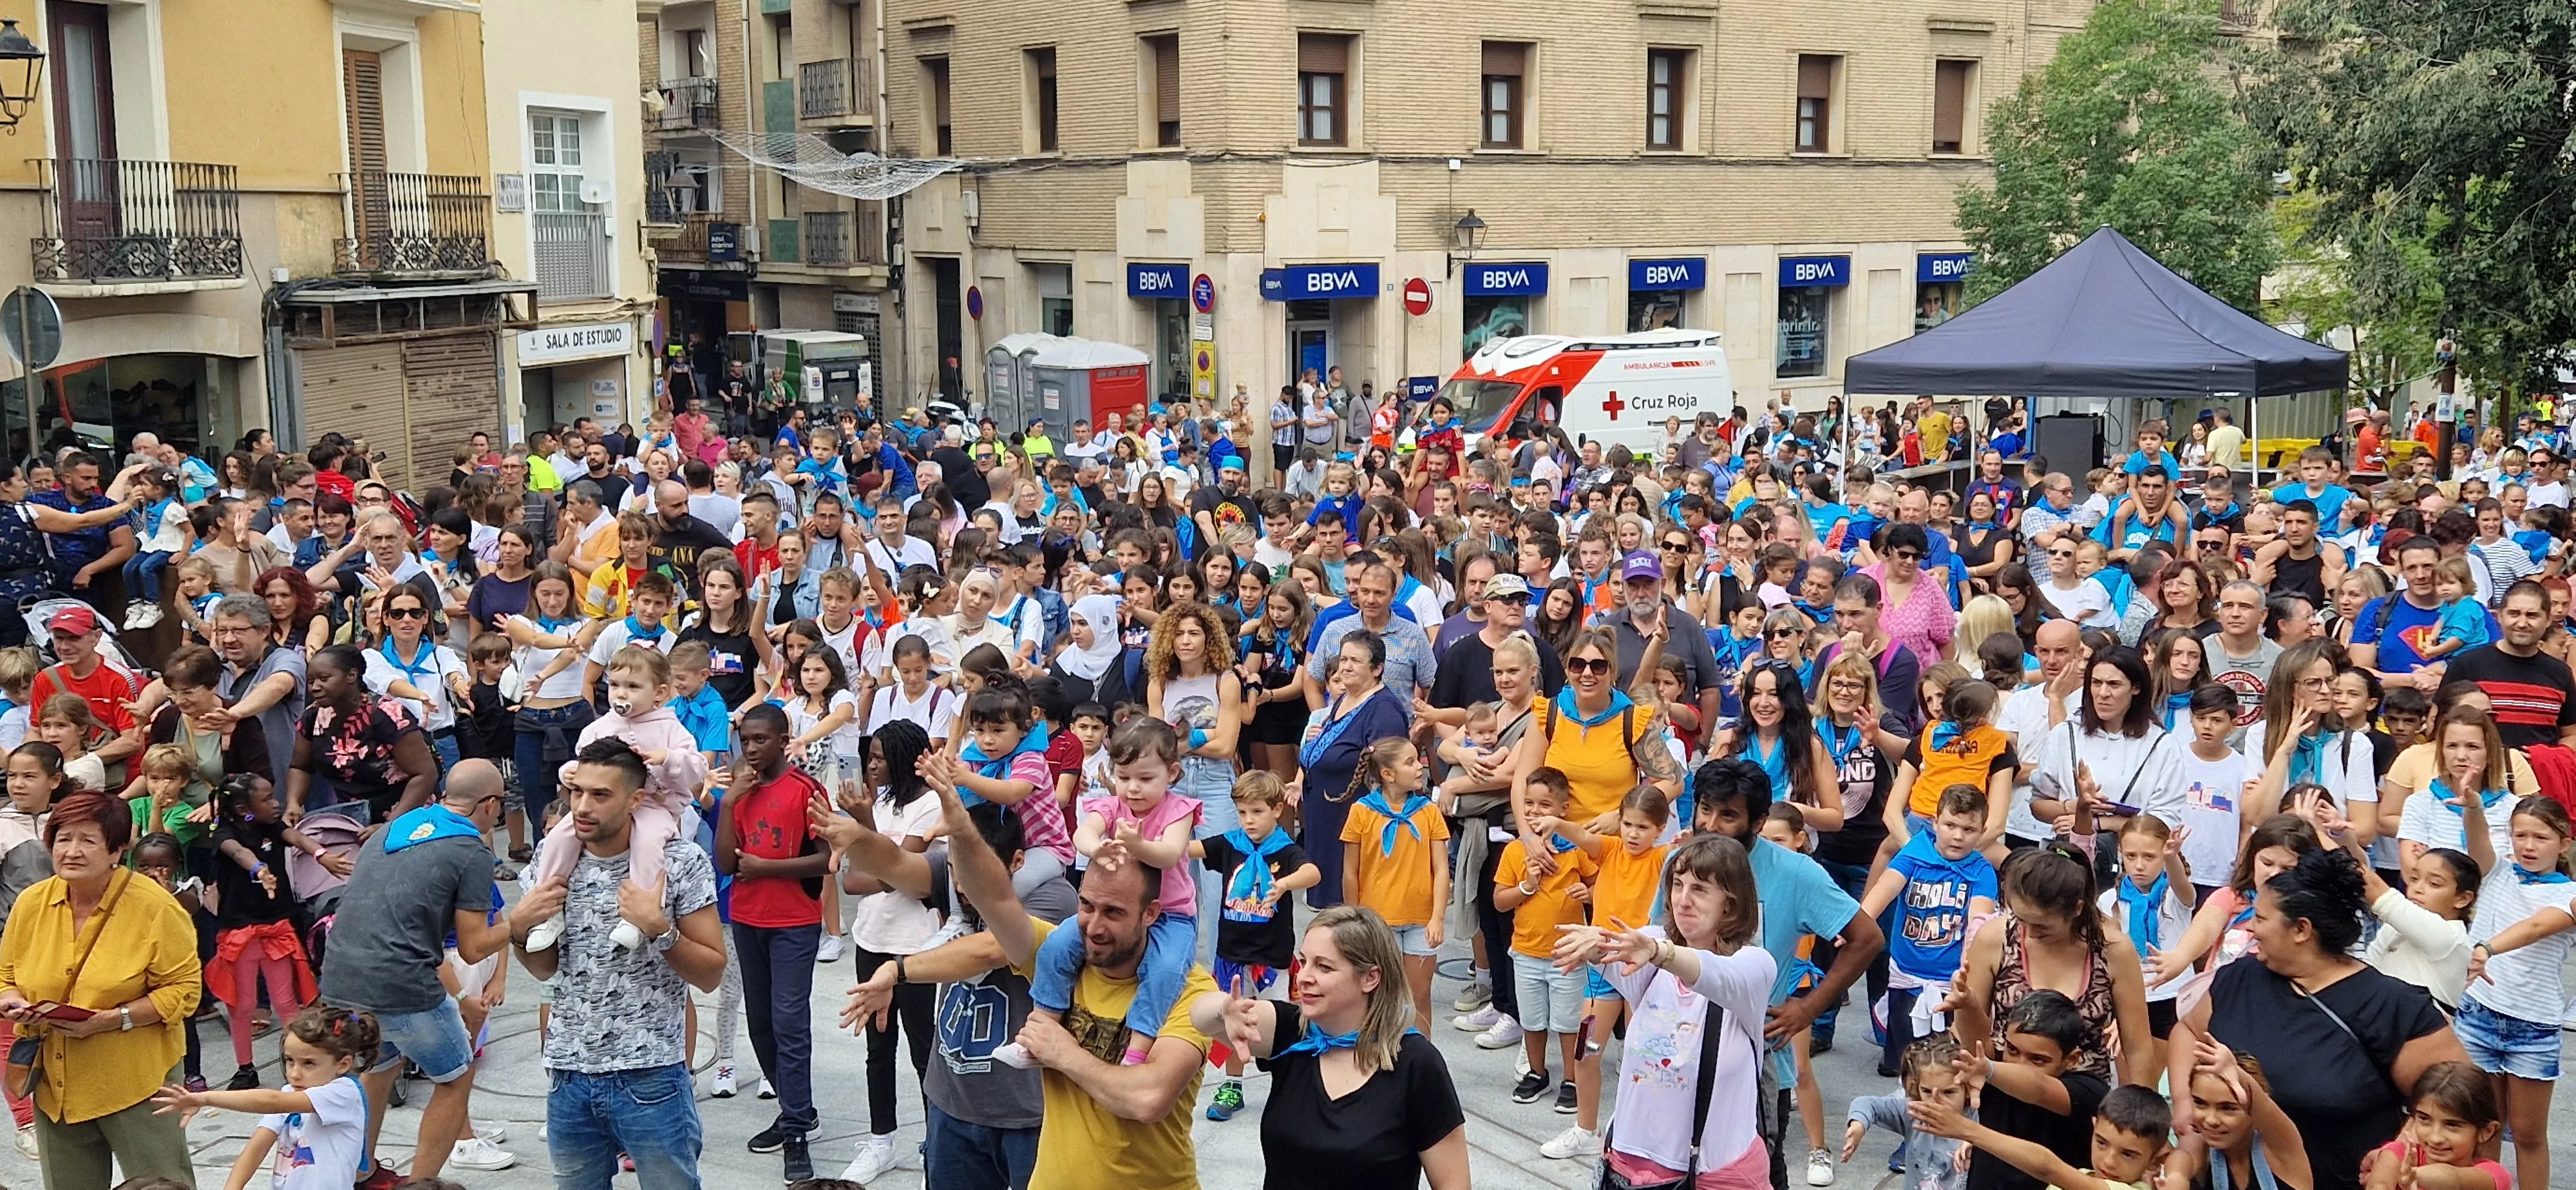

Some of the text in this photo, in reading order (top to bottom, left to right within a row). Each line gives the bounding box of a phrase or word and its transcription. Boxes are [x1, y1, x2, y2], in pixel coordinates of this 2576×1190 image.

[1646, 264, 1689, 284] BBVA
[1795, 261, 1835, 281] BBVA
[1933, 258, 1968, 276] BBVA
[1139, 270, 1173, 290] BBVA
[1265, 280, 1282, 289] BBVA
[1307, 269, 1359, 292] BBVA
[1482, 268, 1530, 288] BBVA
[546, 328, 621, 350] SALA DE ESTUDIO
[1624, 361, 1671, 370] AMBULANCIA
[1413, 384, 1434, 395] BBVA
[1631, 392, 1698, 410] Cruz Roja
